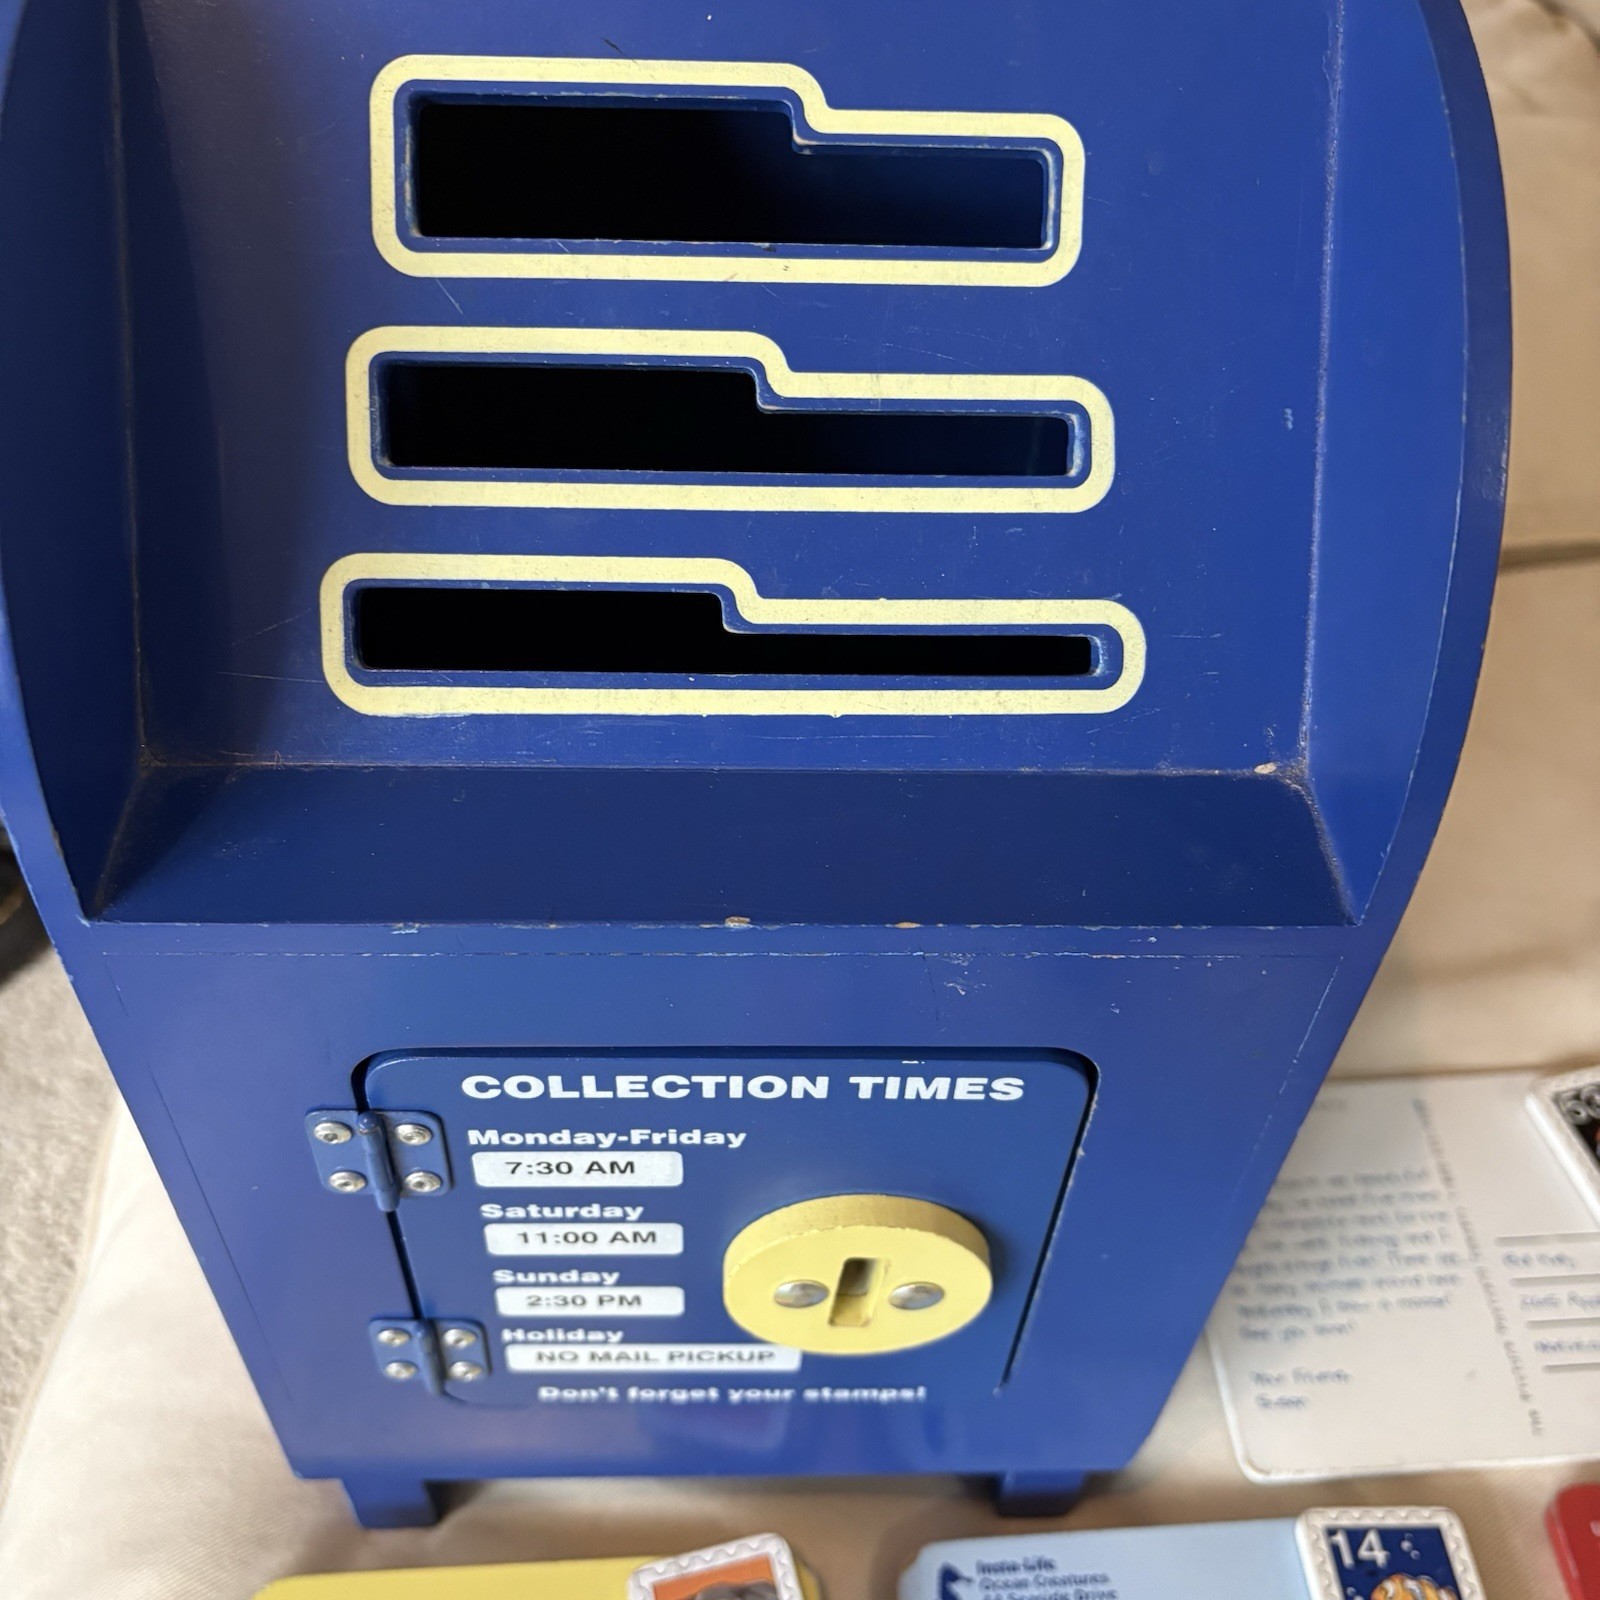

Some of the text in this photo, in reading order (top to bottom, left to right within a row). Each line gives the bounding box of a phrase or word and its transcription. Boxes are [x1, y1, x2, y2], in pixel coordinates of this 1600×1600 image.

[461, 1074, 1025, 1101] COLLECTION TIMES
[467, 1128, 747, 1148] Monday-Friday
[505, 1160, 635, 1175] 7:30 AM
[480, 1203, 645, 1221] Saturday
[517, 1231, 657, 1245] 11:00 AM
[492, 1269, 620, 1286] Sunday
[525, 1294, 643, 1308] 2:30 PM
[501, 1328, 624, 1344] Holiday
[536, 1349, 775, 1363] NO MAIL PICKUP
[537, 1384, 927, 1405] Don't forget your stamps!
[1329, 1528, 1390, 1570] 14
